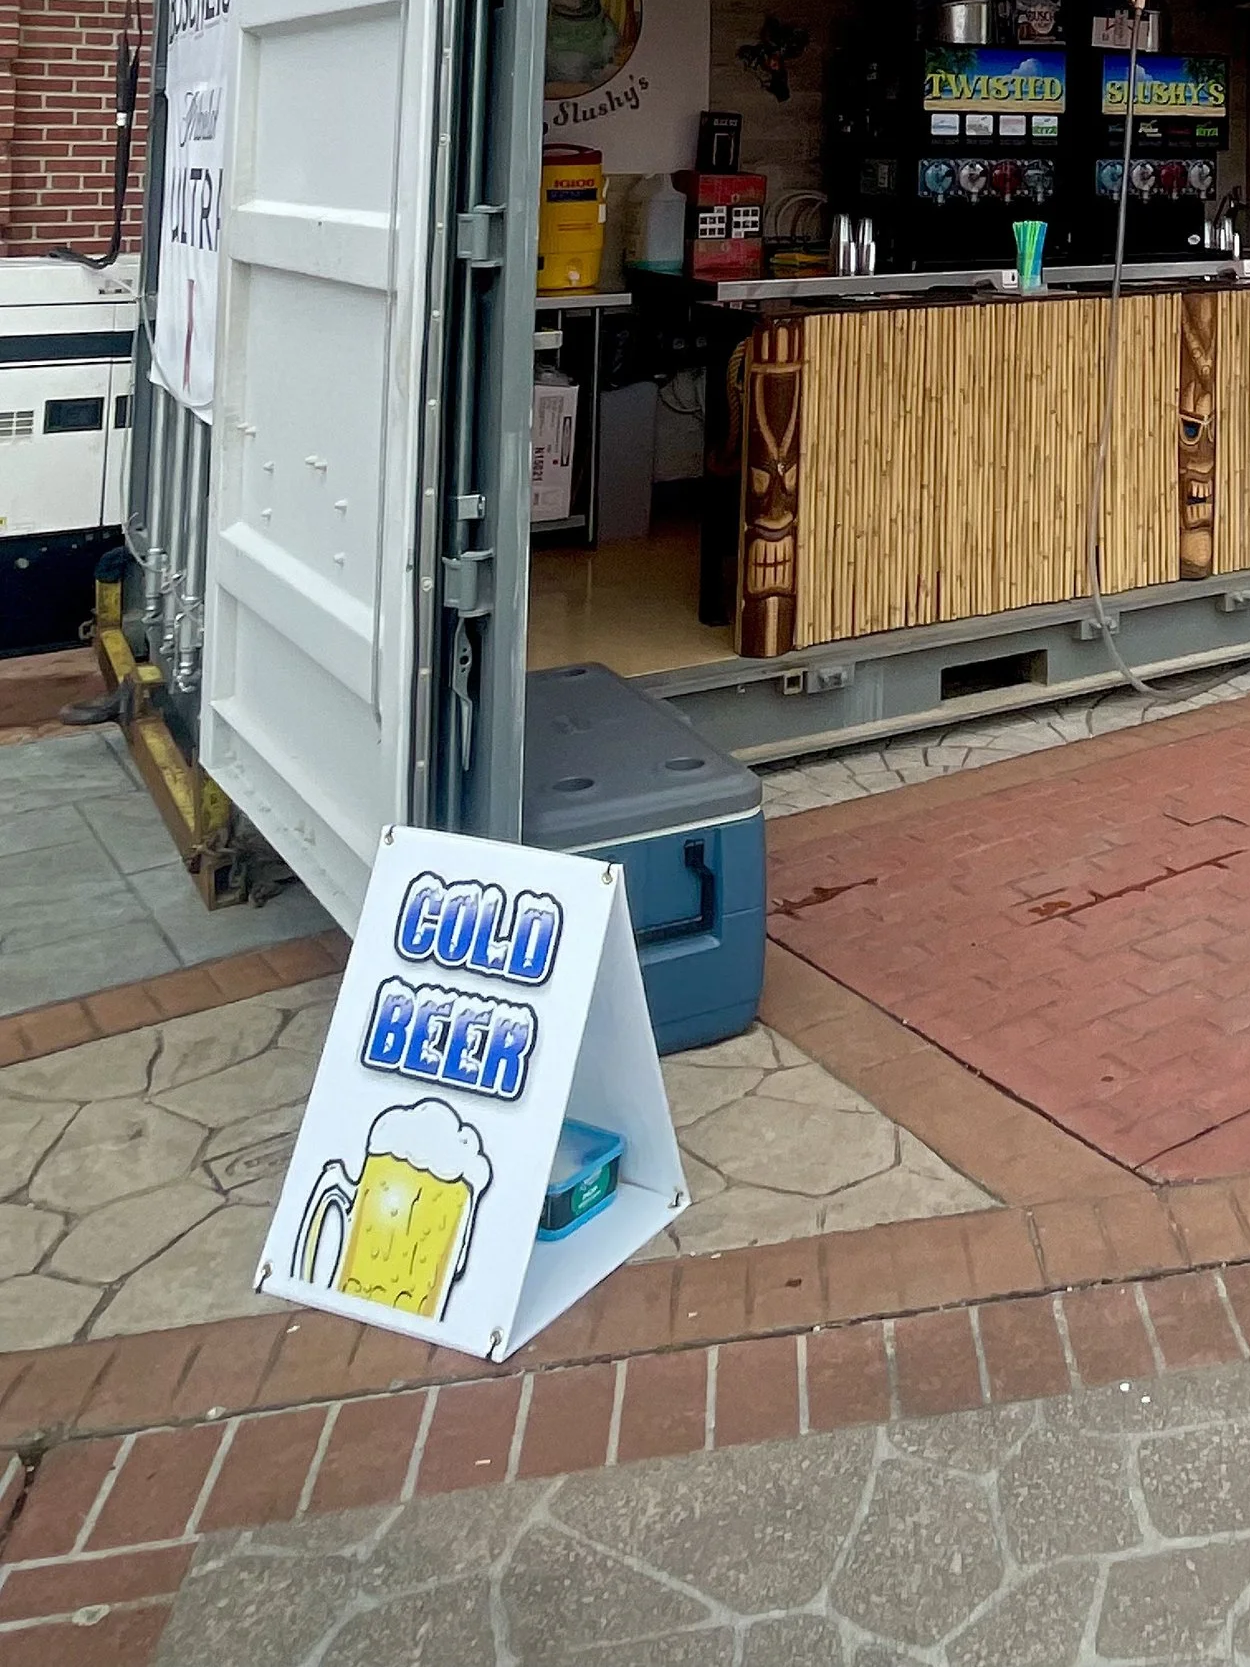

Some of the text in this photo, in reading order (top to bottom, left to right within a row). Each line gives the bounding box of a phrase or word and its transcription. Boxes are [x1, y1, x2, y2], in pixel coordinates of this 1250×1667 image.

[552, 73, 650, 126] Slushy's
[925, 71, 1063, 101] TWISTED
[393, 871, 564, 987] COLD
[361, 975, 539, 1102] BEER
